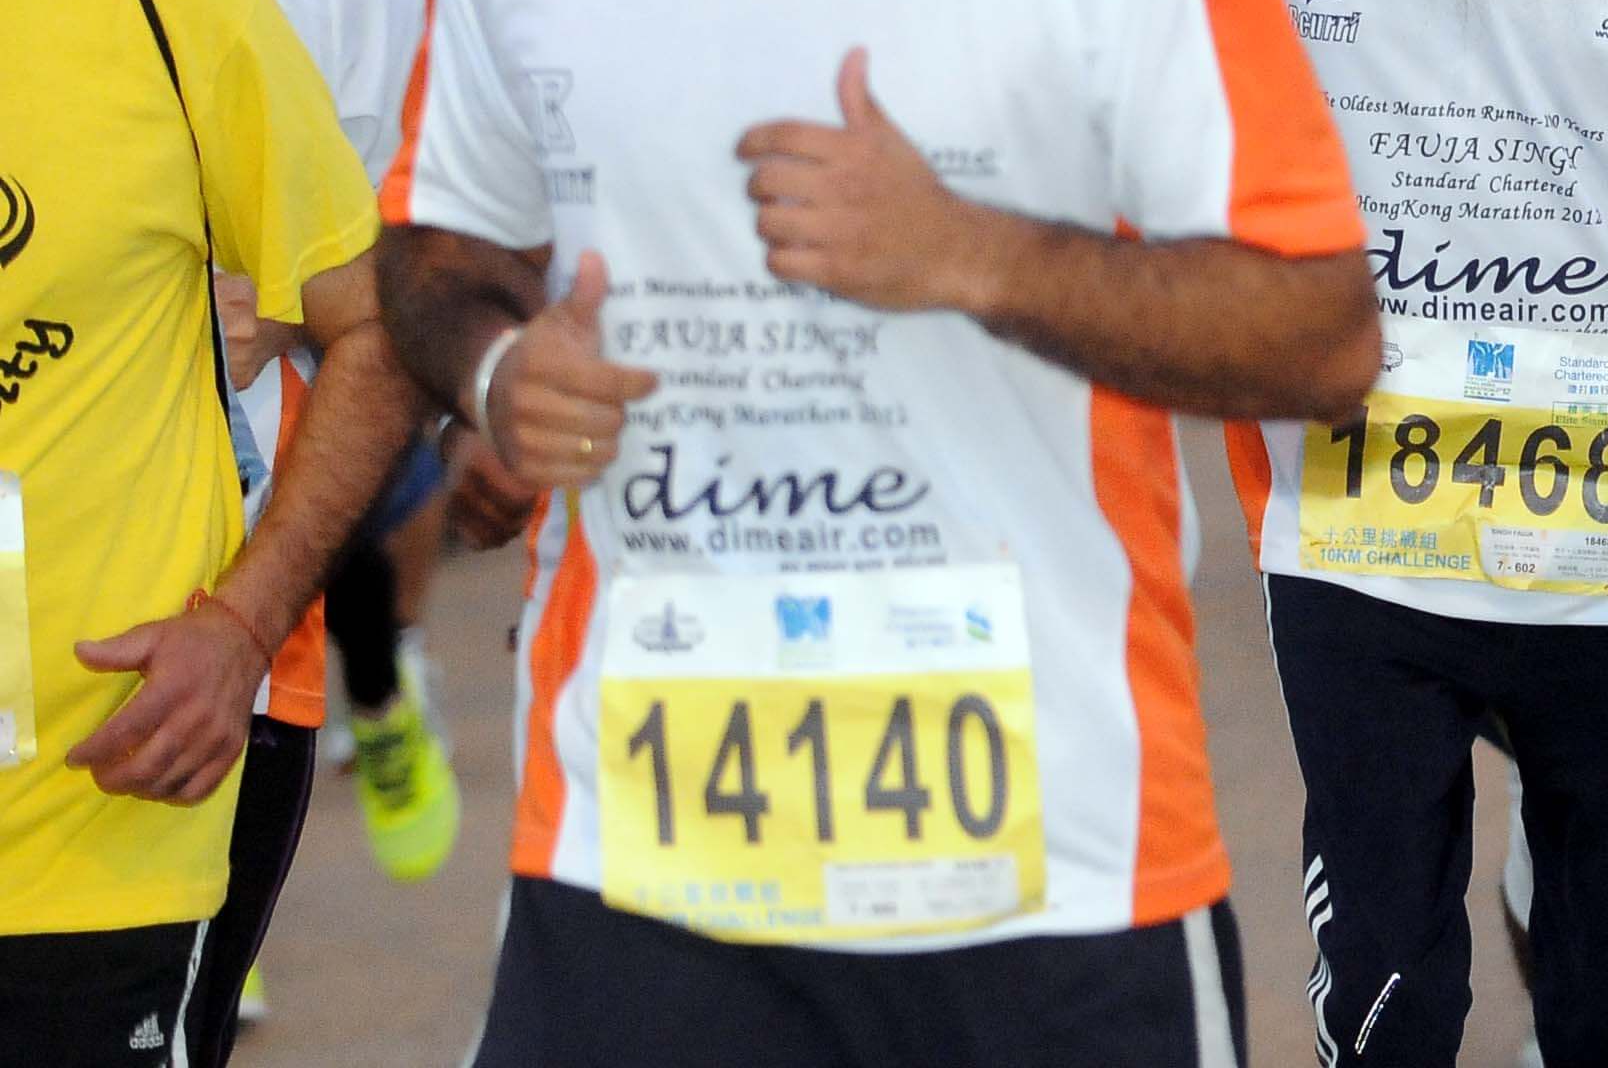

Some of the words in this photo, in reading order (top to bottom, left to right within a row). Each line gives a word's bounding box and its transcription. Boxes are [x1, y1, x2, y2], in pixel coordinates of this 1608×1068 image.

[1340, 94, 1388, 114] Oldest
[1392, 101, 1477, 119] Marathon
[1369, 132, 1480, 164] FAUJA
[1391, 170, 1482, 192] Standard
[1489, 173, 1577, 198] Chartered
[1458, 200, 1555, 221] Marathon
[662, 366, 749, 388] tandard
[624, 442, 930, 522] dime
[623, 524, 942, 555] www.dimeair.com
[1320, 547, 1361, 564] 10KM
[1367, 550, 1472, 570] CHALLENGE
[1515, 562, 1536, 574] 602
[629, 692, 1011, 847] 14140
